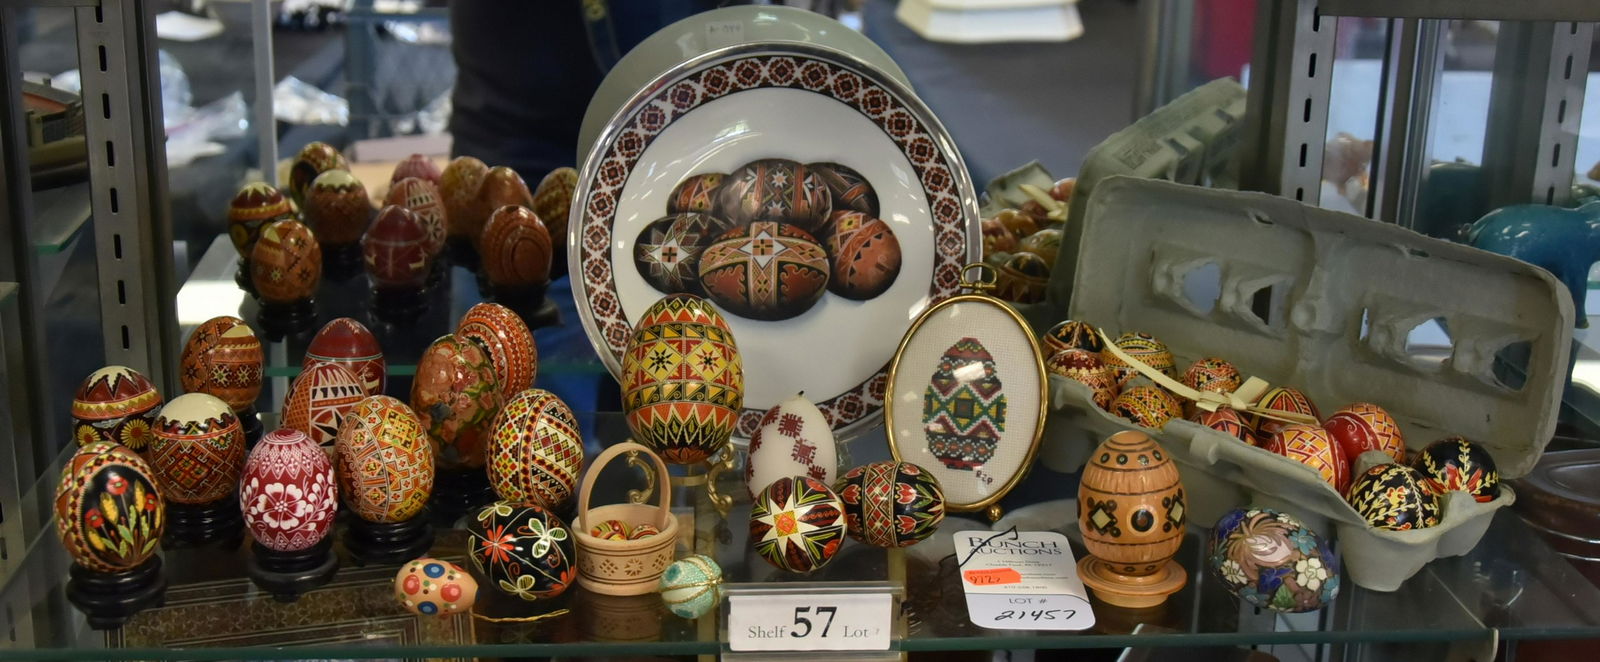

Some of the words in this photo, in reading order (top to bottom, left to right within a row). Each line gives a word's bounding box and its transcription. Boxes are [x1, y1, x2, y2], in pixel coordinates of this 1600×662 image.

[968, 536, 1057, 548] BUNCH
[969, 547, 1062, 556] AUCTIONS
[994, 609, 1077, 621] 21457
[748, 625, 787, 639] Shelf
[790, 605, 838, 638] 57
[844, 625, 869, 638] Lot
